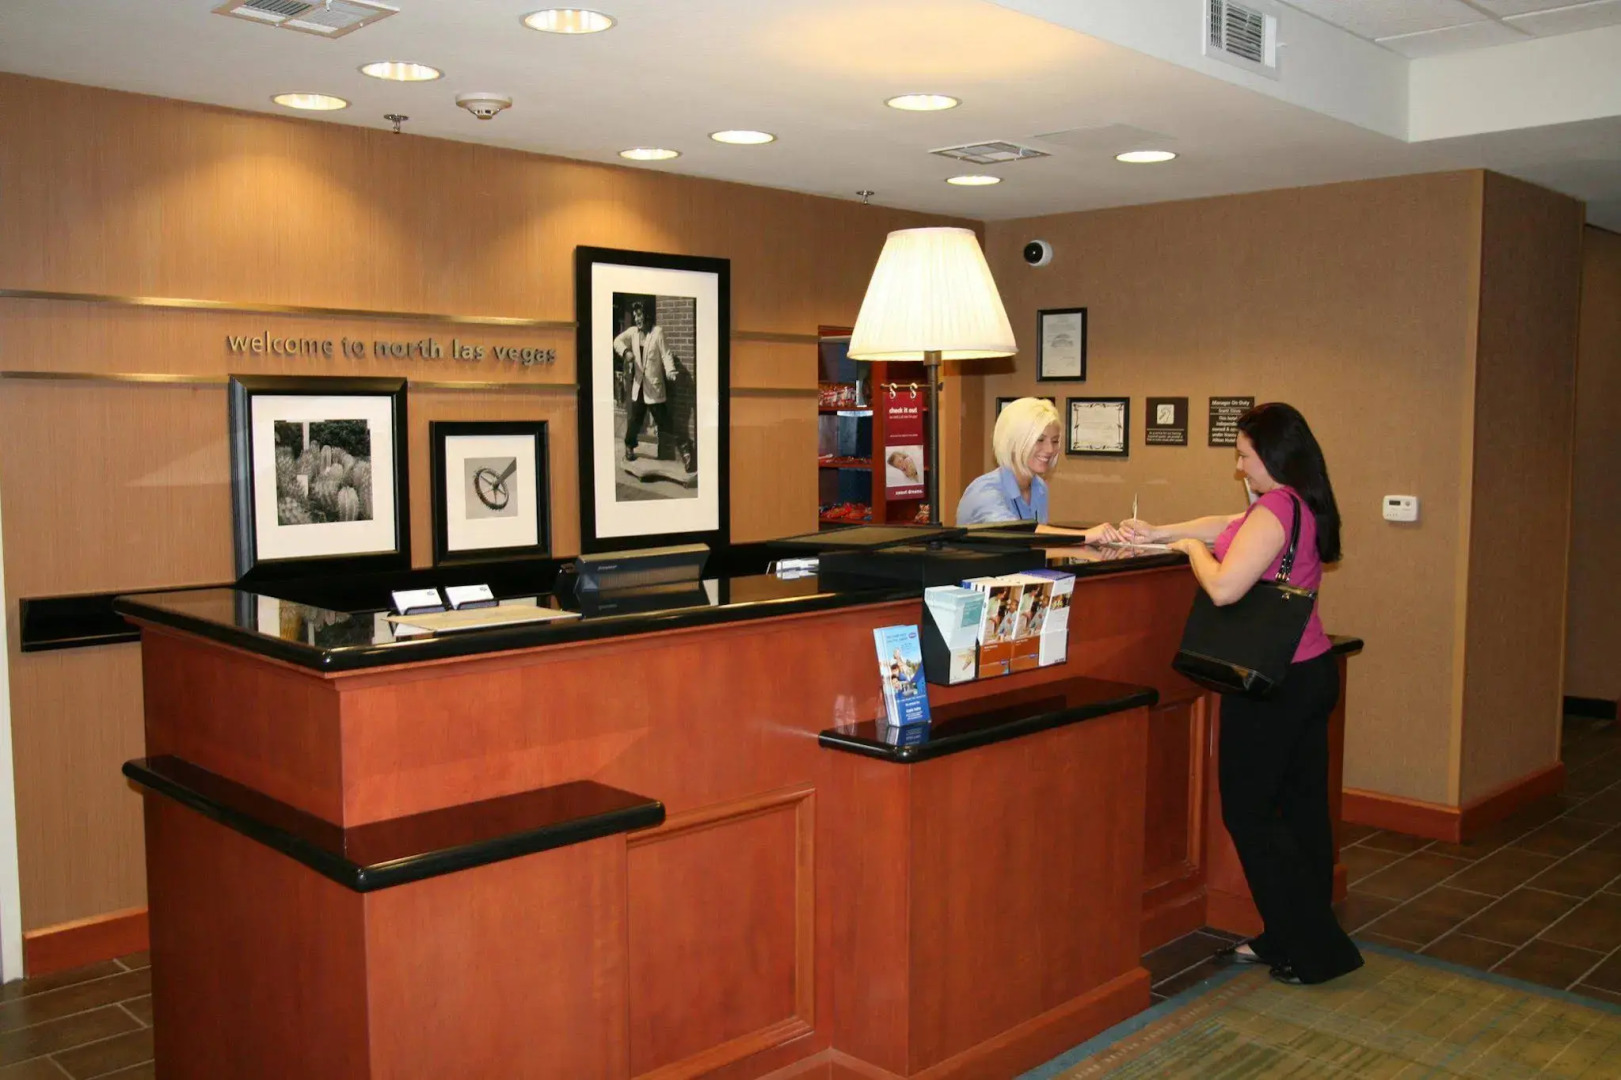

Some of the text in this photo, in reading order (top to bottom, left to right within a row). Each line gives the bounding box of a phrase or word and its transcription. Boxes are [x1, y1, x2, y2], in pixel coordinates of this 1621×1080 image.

[226, 330, 557, 367] welcome to north las vegas
